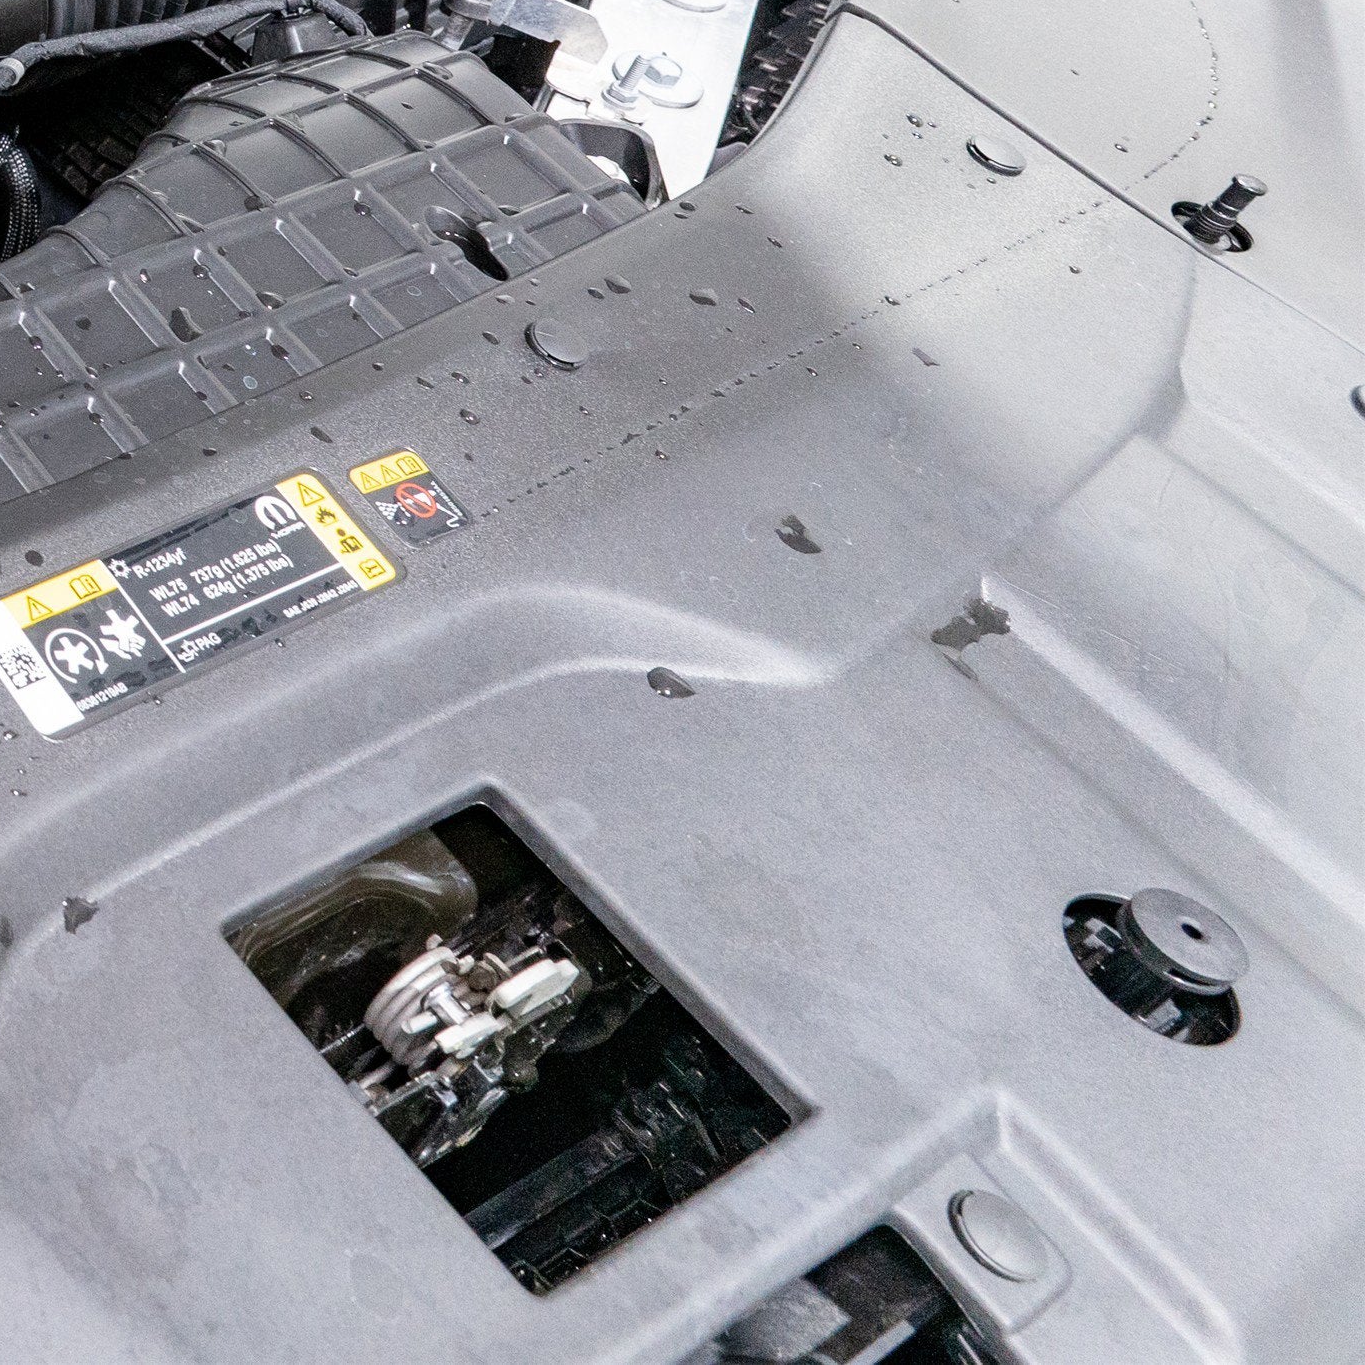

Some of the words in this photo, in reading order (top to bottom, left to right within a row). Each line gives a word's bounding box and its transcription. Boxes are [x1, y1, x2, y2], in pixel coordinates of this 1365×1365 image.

[132, 548, 187, 579] R-1234yf
[149, 578, 188, 602] WL75
[190, 563, 225, 585] 737g
[220, 545, 258, 575] (1.625
[161, 593, 200, 618] WL74
[203, 578, 237, 600] 624g
[232, 562, 270, 590] (1.375
[196, 632, 222, 652] PAG
